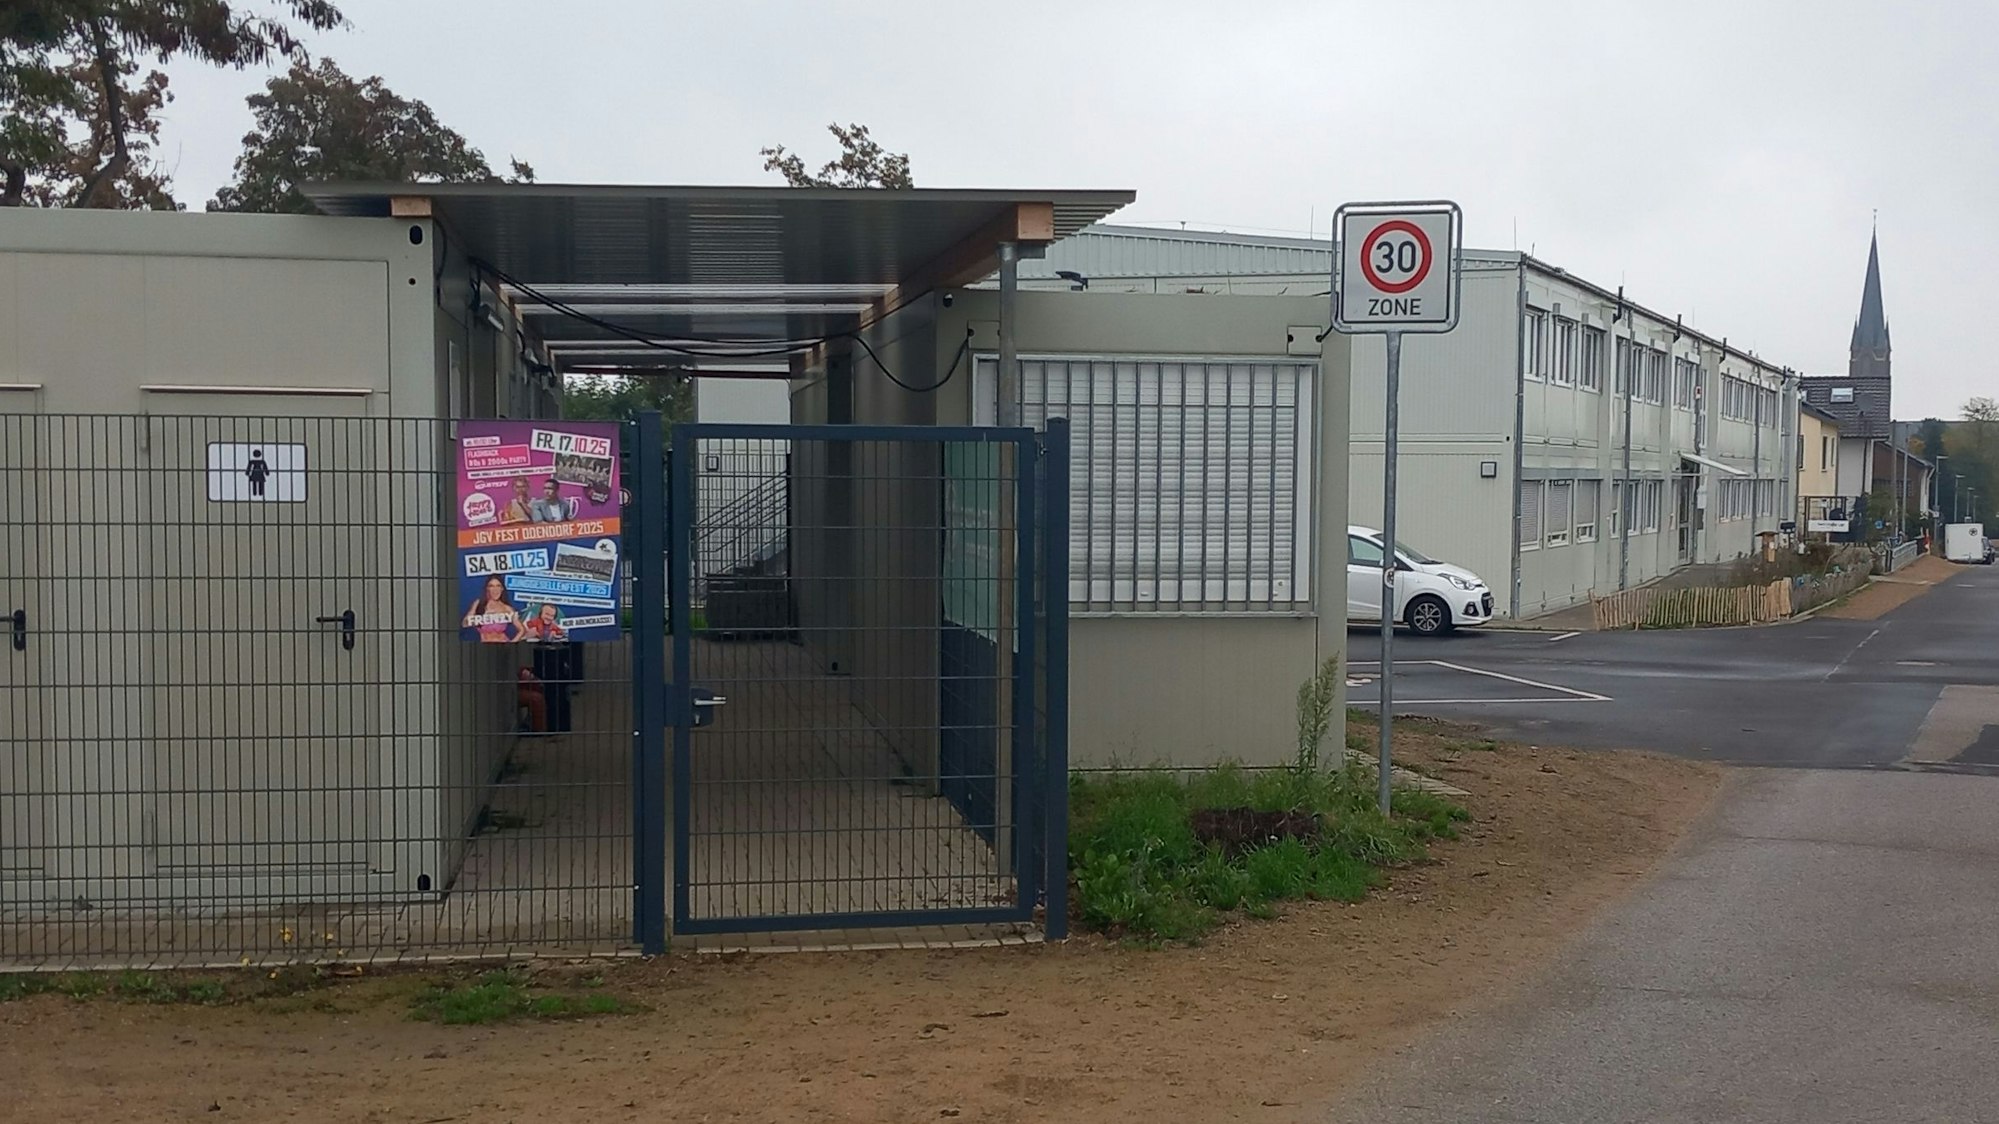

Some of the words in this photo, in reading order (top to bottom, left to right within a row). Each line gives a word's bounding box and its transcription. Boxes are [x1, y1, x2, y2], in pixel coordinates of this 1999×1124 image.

[1375, 240, 1416, 273] 30
[1368, 298, 1421, 316] ZONE
[536, 432, 555, 449] FR.
[559, 435, 608, 456] 17.10.25
[473, 531, 496, 544] JGV
[496, 528, 519, 542] FEST
[522, 524, 575, 540] ODENDORF
[577, 521, 604, 535] 2025
[469, 556, 491, 573] SA.
[494, 551, 546, 571] 18.10.25
